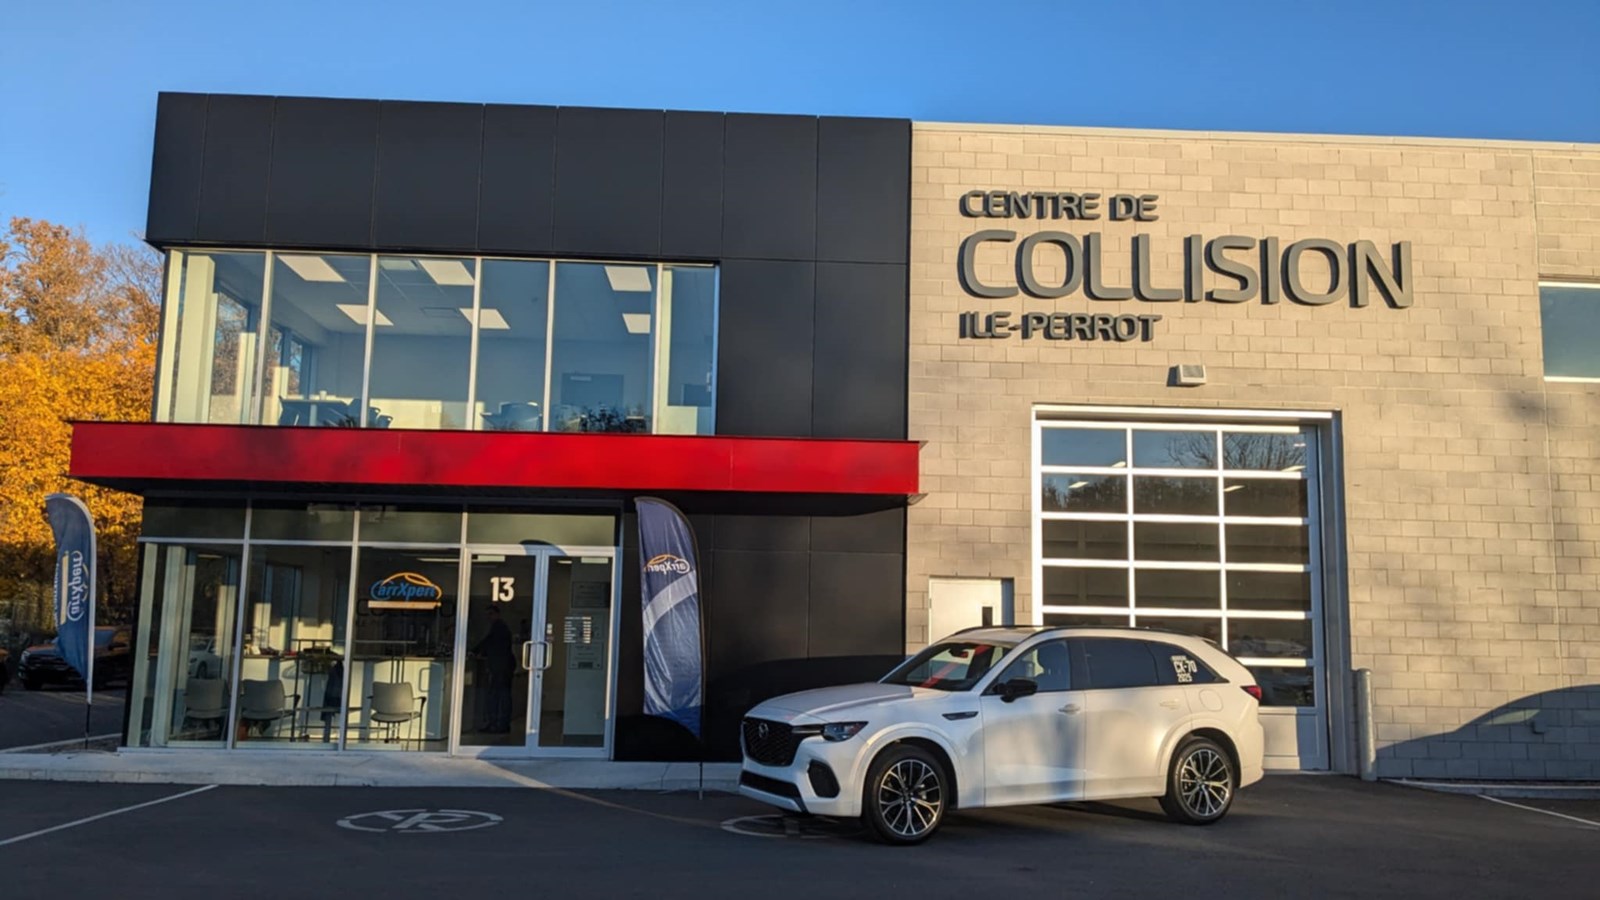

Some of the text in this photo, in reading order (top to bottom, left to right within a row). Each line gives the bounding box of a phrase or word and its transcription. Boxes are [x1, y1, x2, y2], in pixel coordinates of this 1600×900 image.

[960, 190, 1159, 221] CENTRE DE
[957, 229, 1413, 308] COLLISION
[959, 311, 1162, 342] ILE-PERROT
[490, 576, 515, 602] 13
[1173, 660, 1197, 673] CX-70
